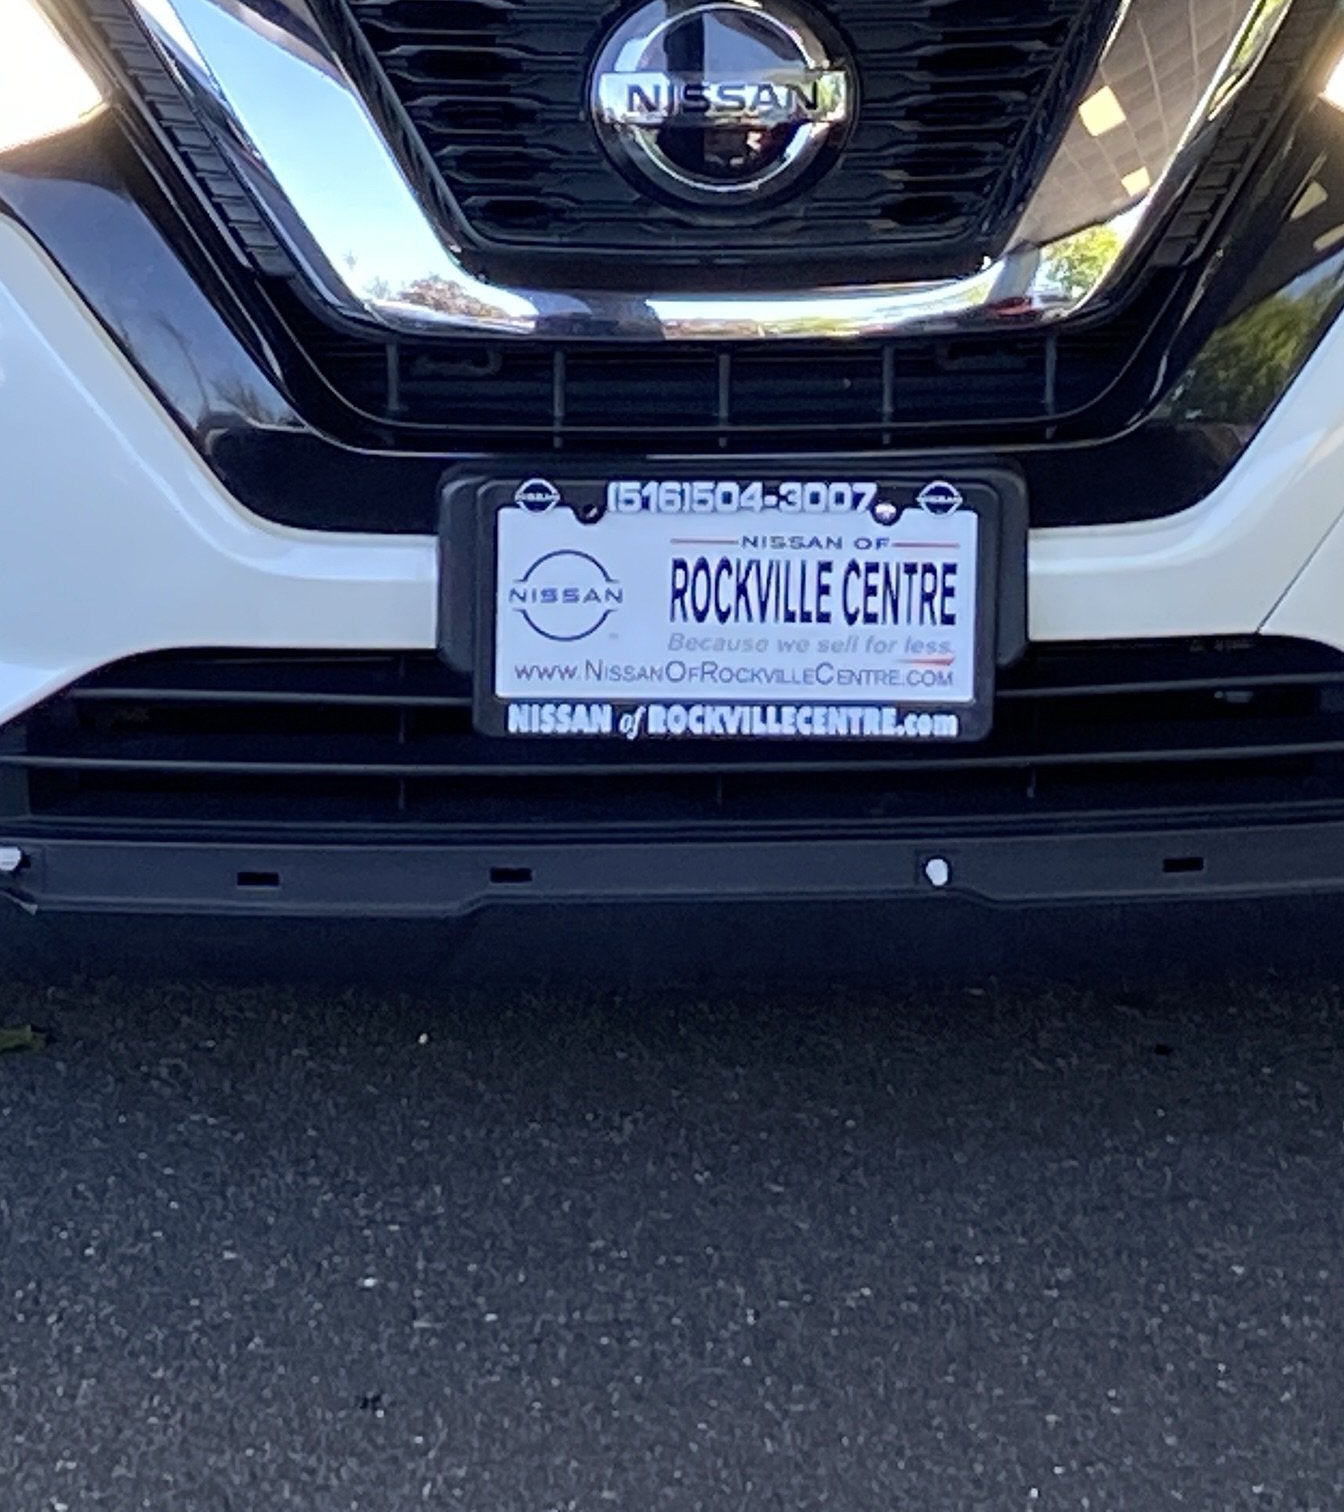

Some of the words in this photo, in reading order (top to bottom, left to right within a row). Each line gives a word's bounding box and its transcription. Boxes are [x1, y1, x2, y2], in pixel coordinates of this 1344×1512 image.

[627, 83, 820, 113] NISSAN
[741, 536, 843, 550] NISSAN
[854, 537, 891, 551] OF
[508, 587, 624, 604] NISSAN
[669, 556, 833, 624] ROCKVILLE
[842, 558, 958, 627] CENTRE
[667, 632, 769, 654] Because
[777, 638, 811, 654] we
[817, 635, 859, 654] sell
[864, 635, 898, 655] for
[507, 703, 613, 734] NISSAN
[619, 705, 647, 740] of
[647, 704, 959, 736] ROCKVILLECENTRE.com
